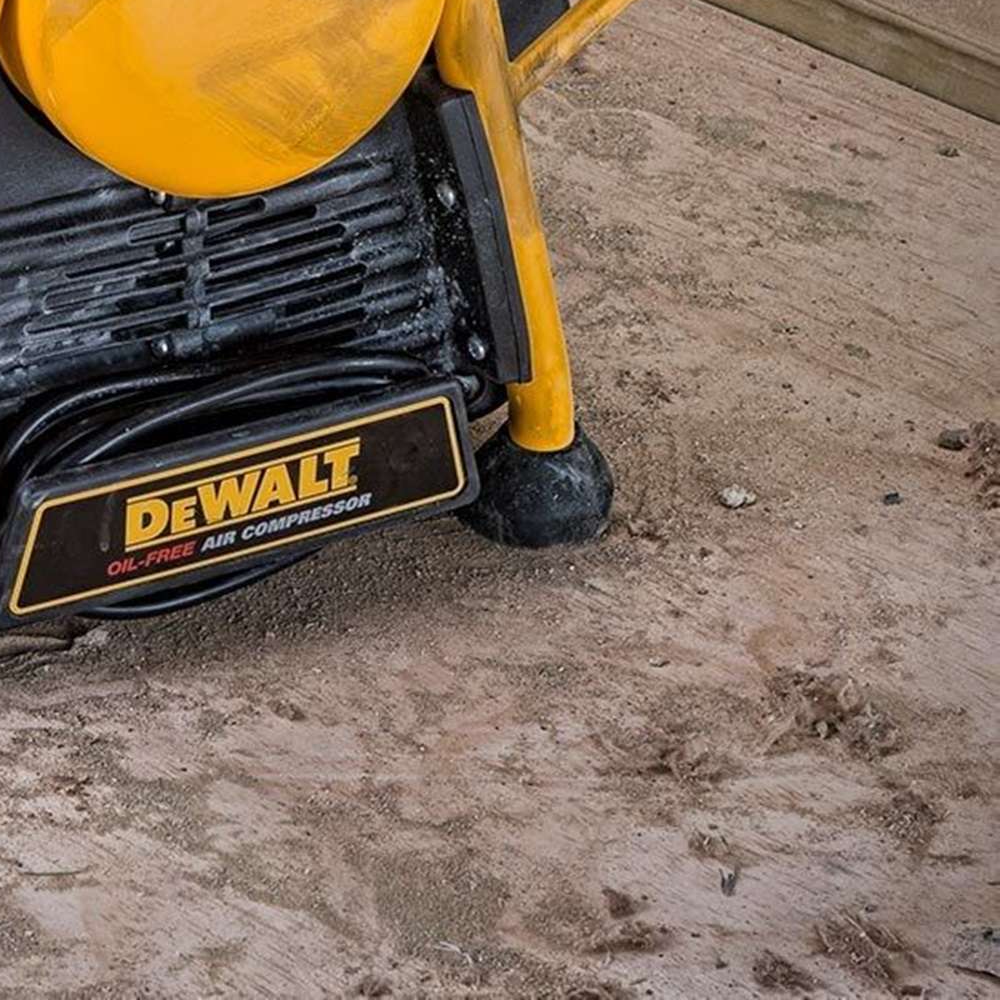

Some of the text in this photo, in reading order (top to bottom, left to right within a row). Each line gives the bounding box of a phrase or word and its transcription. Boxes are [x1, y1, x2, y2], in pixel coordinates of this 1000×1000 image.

[107, 492, 372, 577] OIL-FREE AIR COMPRESSOR
[125, 444, 360, 547] DEWALT
